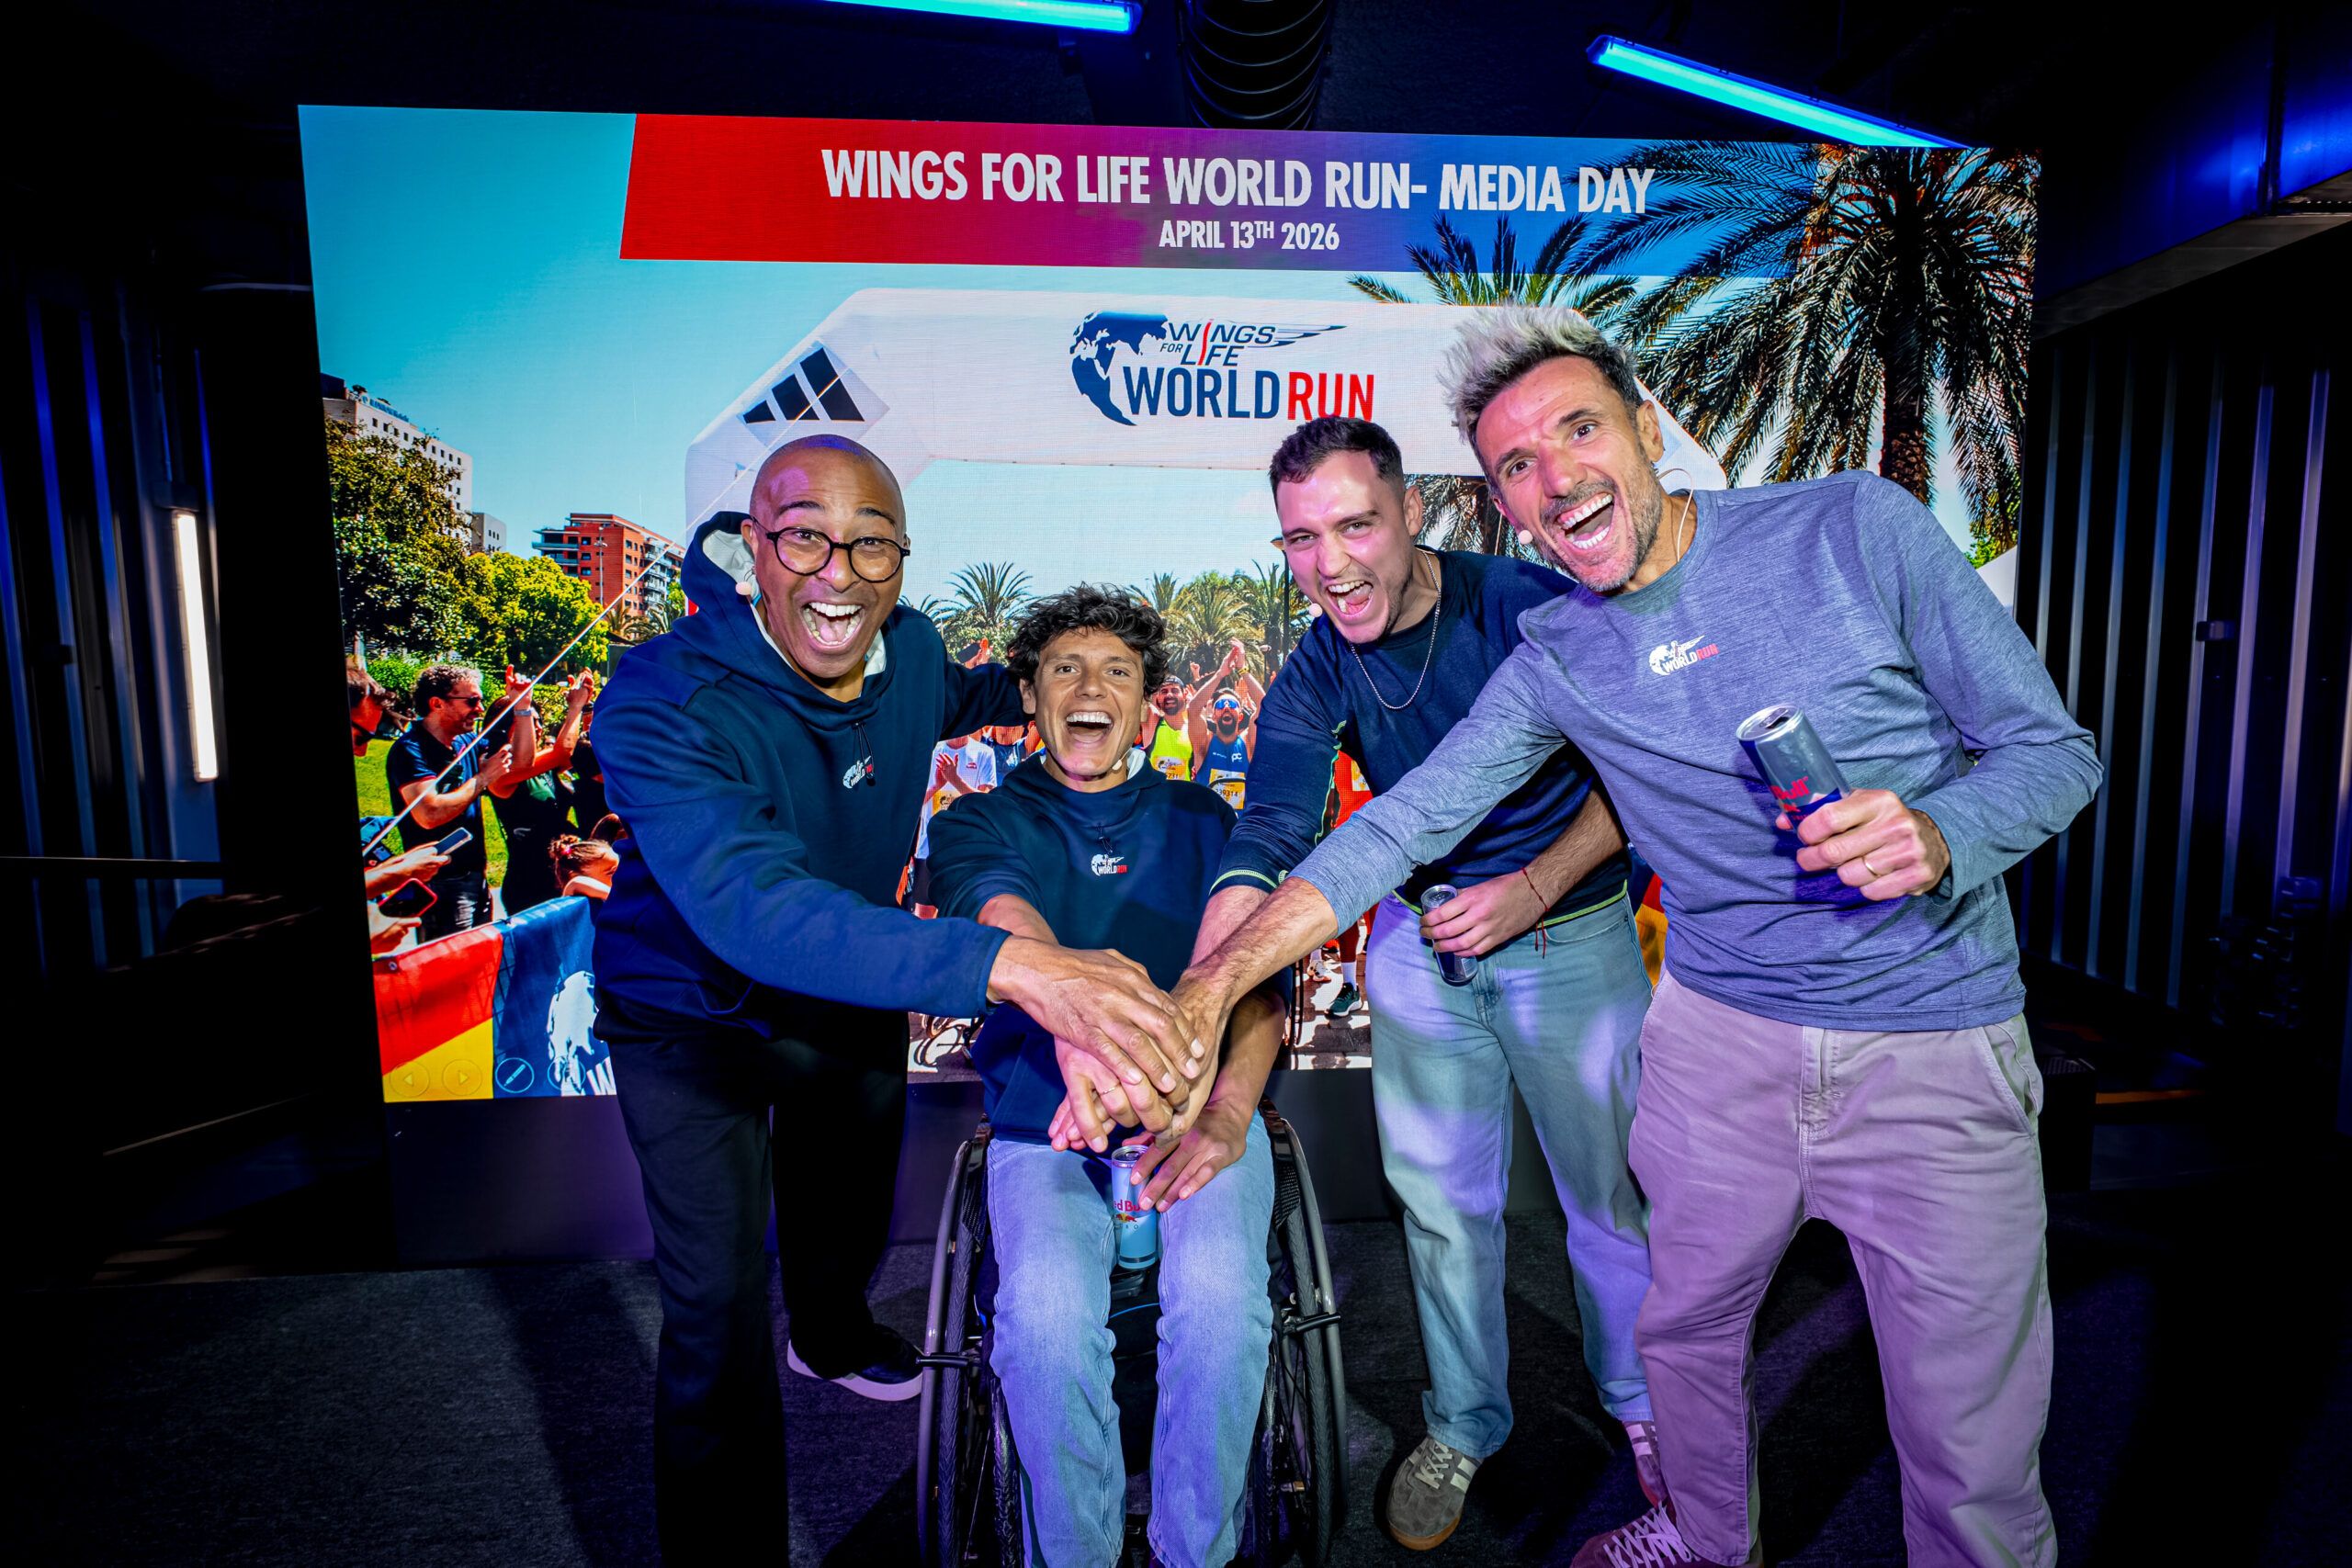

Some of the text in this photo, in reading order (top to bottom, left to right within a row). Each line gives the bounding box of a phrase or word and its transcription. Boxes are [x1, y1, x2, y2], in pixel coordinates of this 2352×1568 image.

[821, 149, 1656, 214] WINGS FOR LIFE WORLD RUN- MEDIA DAY
[1159, 220, 1340, 251] APRIL 13TH 2026
[1168, 322, 1276, 344] WINGS
[1159, 343, 1244, 367] FOR LIFE
[1123, 367, 1374, 422] WORLD RUN
[1662, 651, 1699, 672] WORLD
[1696, 643, 1720, 660] RUN
[1098, 864, 1117, 874] WORLD
